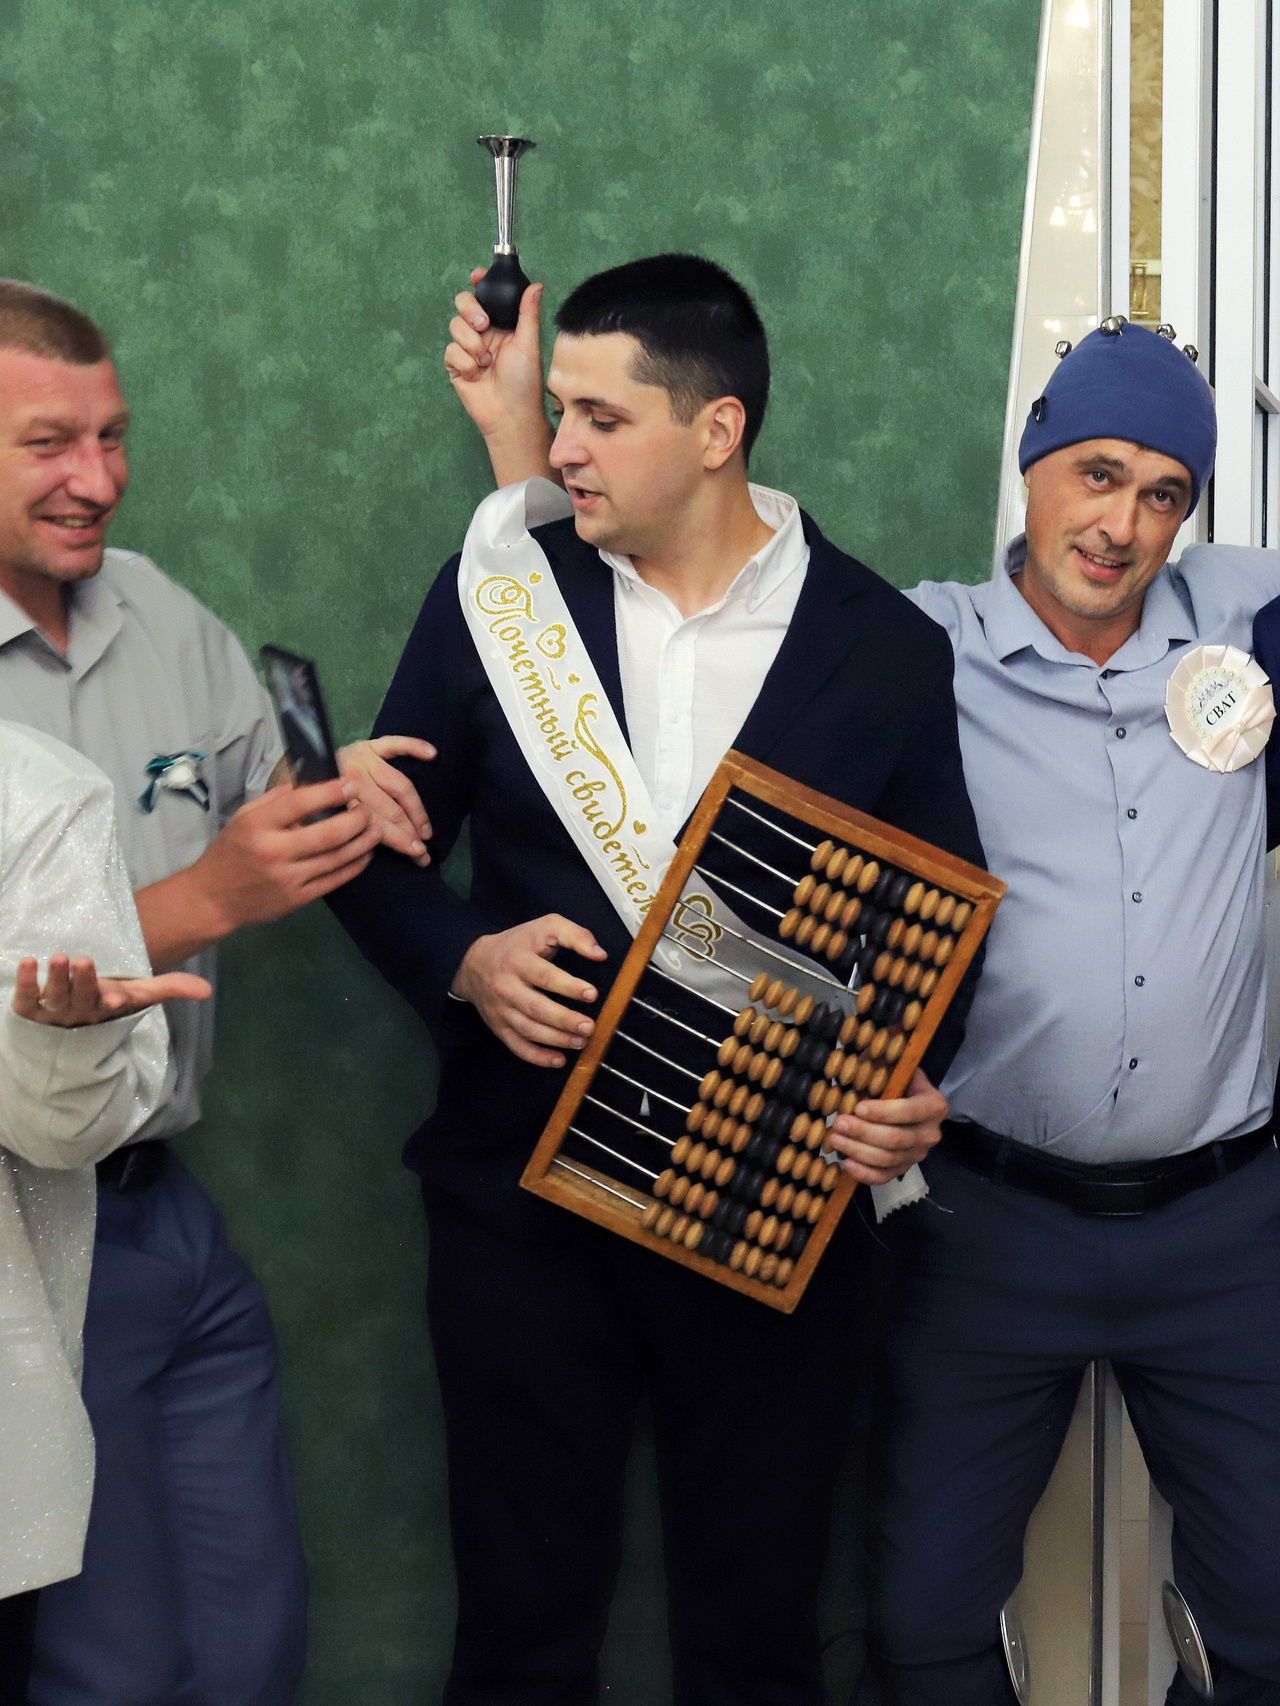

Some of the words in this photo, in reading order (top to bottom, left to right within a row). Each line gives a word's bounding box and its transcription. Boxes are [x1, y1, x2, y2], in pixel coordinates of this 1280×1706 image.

[475, 575, 580, 762] Почетный
[564, 693, 658, 914] свидетел
[1205, 690, 1237, 726] СВАТ
